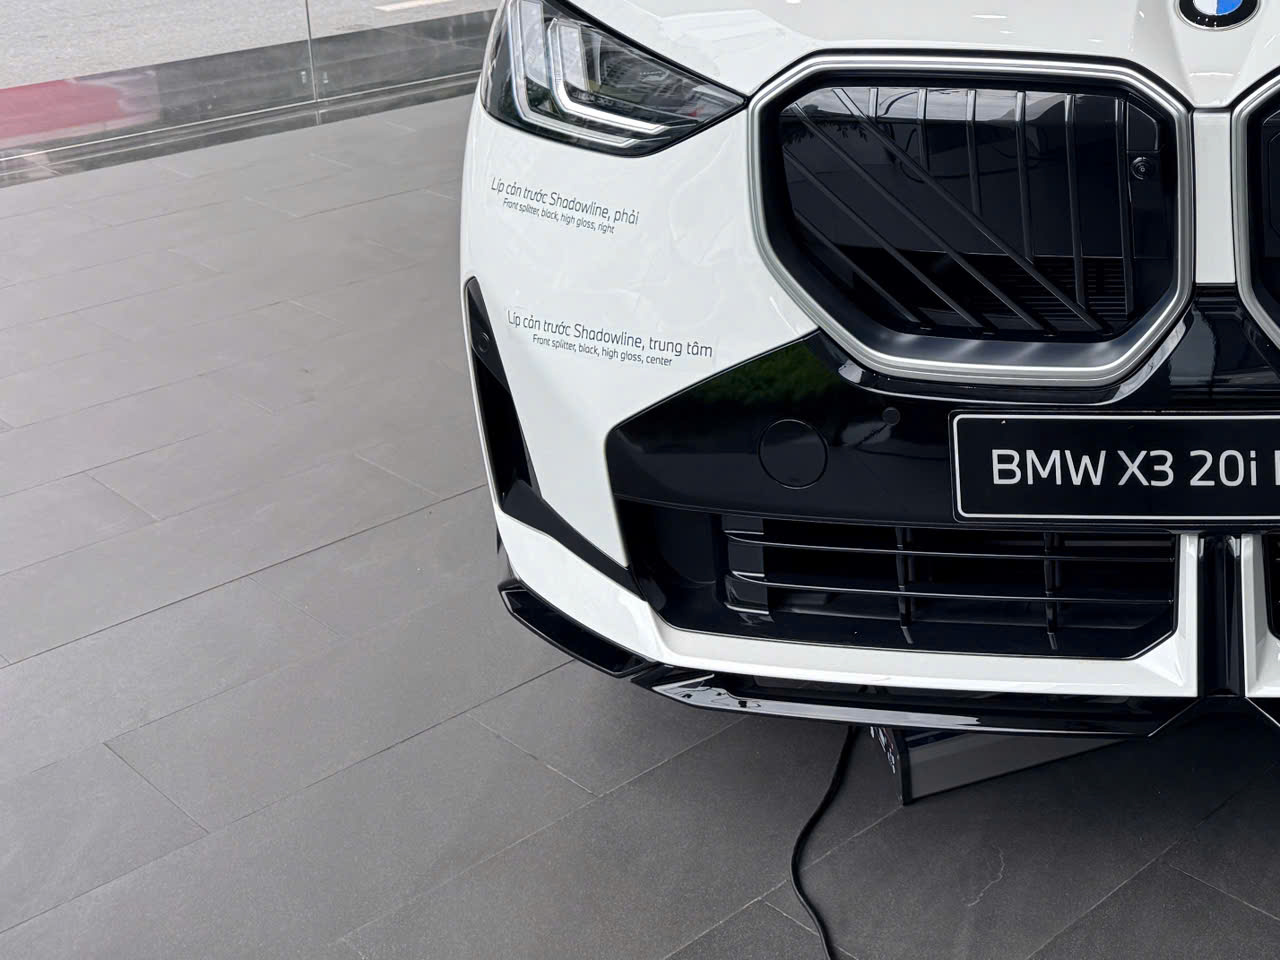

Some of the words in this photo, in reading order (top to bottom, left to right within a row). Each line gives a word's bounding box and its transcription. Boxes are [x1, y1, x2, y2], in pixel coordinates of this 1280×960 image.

[503, 197, 519, 210] Front
[519, 203, 540, 217] splitter,
[541, 207, 560, 222] black,
[560, 212, 576, 226] high
[576, 216, 596, 231] gloss,
[597, 221, 615, 235] right
[523, 186, 548, 204] trước
[549, 191, 610, 222] Shadowline,
[614, 208, 640, 225] phải
[532, 333, 551, 346] Front
[551, 338, 577, 352] splitter,
[578, 343, 600, 357] black,
[601, 346, 619, 360] high
[620, 350, 644, 364] gloss,
[645, 355, 673, 366] center
[543, 319, 571, 337] trước
[573, 323, 645, 351] Shadowline,
[649, 336, 683, 357] trung
[686, 340, 713, 358] tâm
[991, 449, 1106, 486] BMW
[1117, 449, 1175, 486] X3
[1189, 449, 1257, 486] 20i
